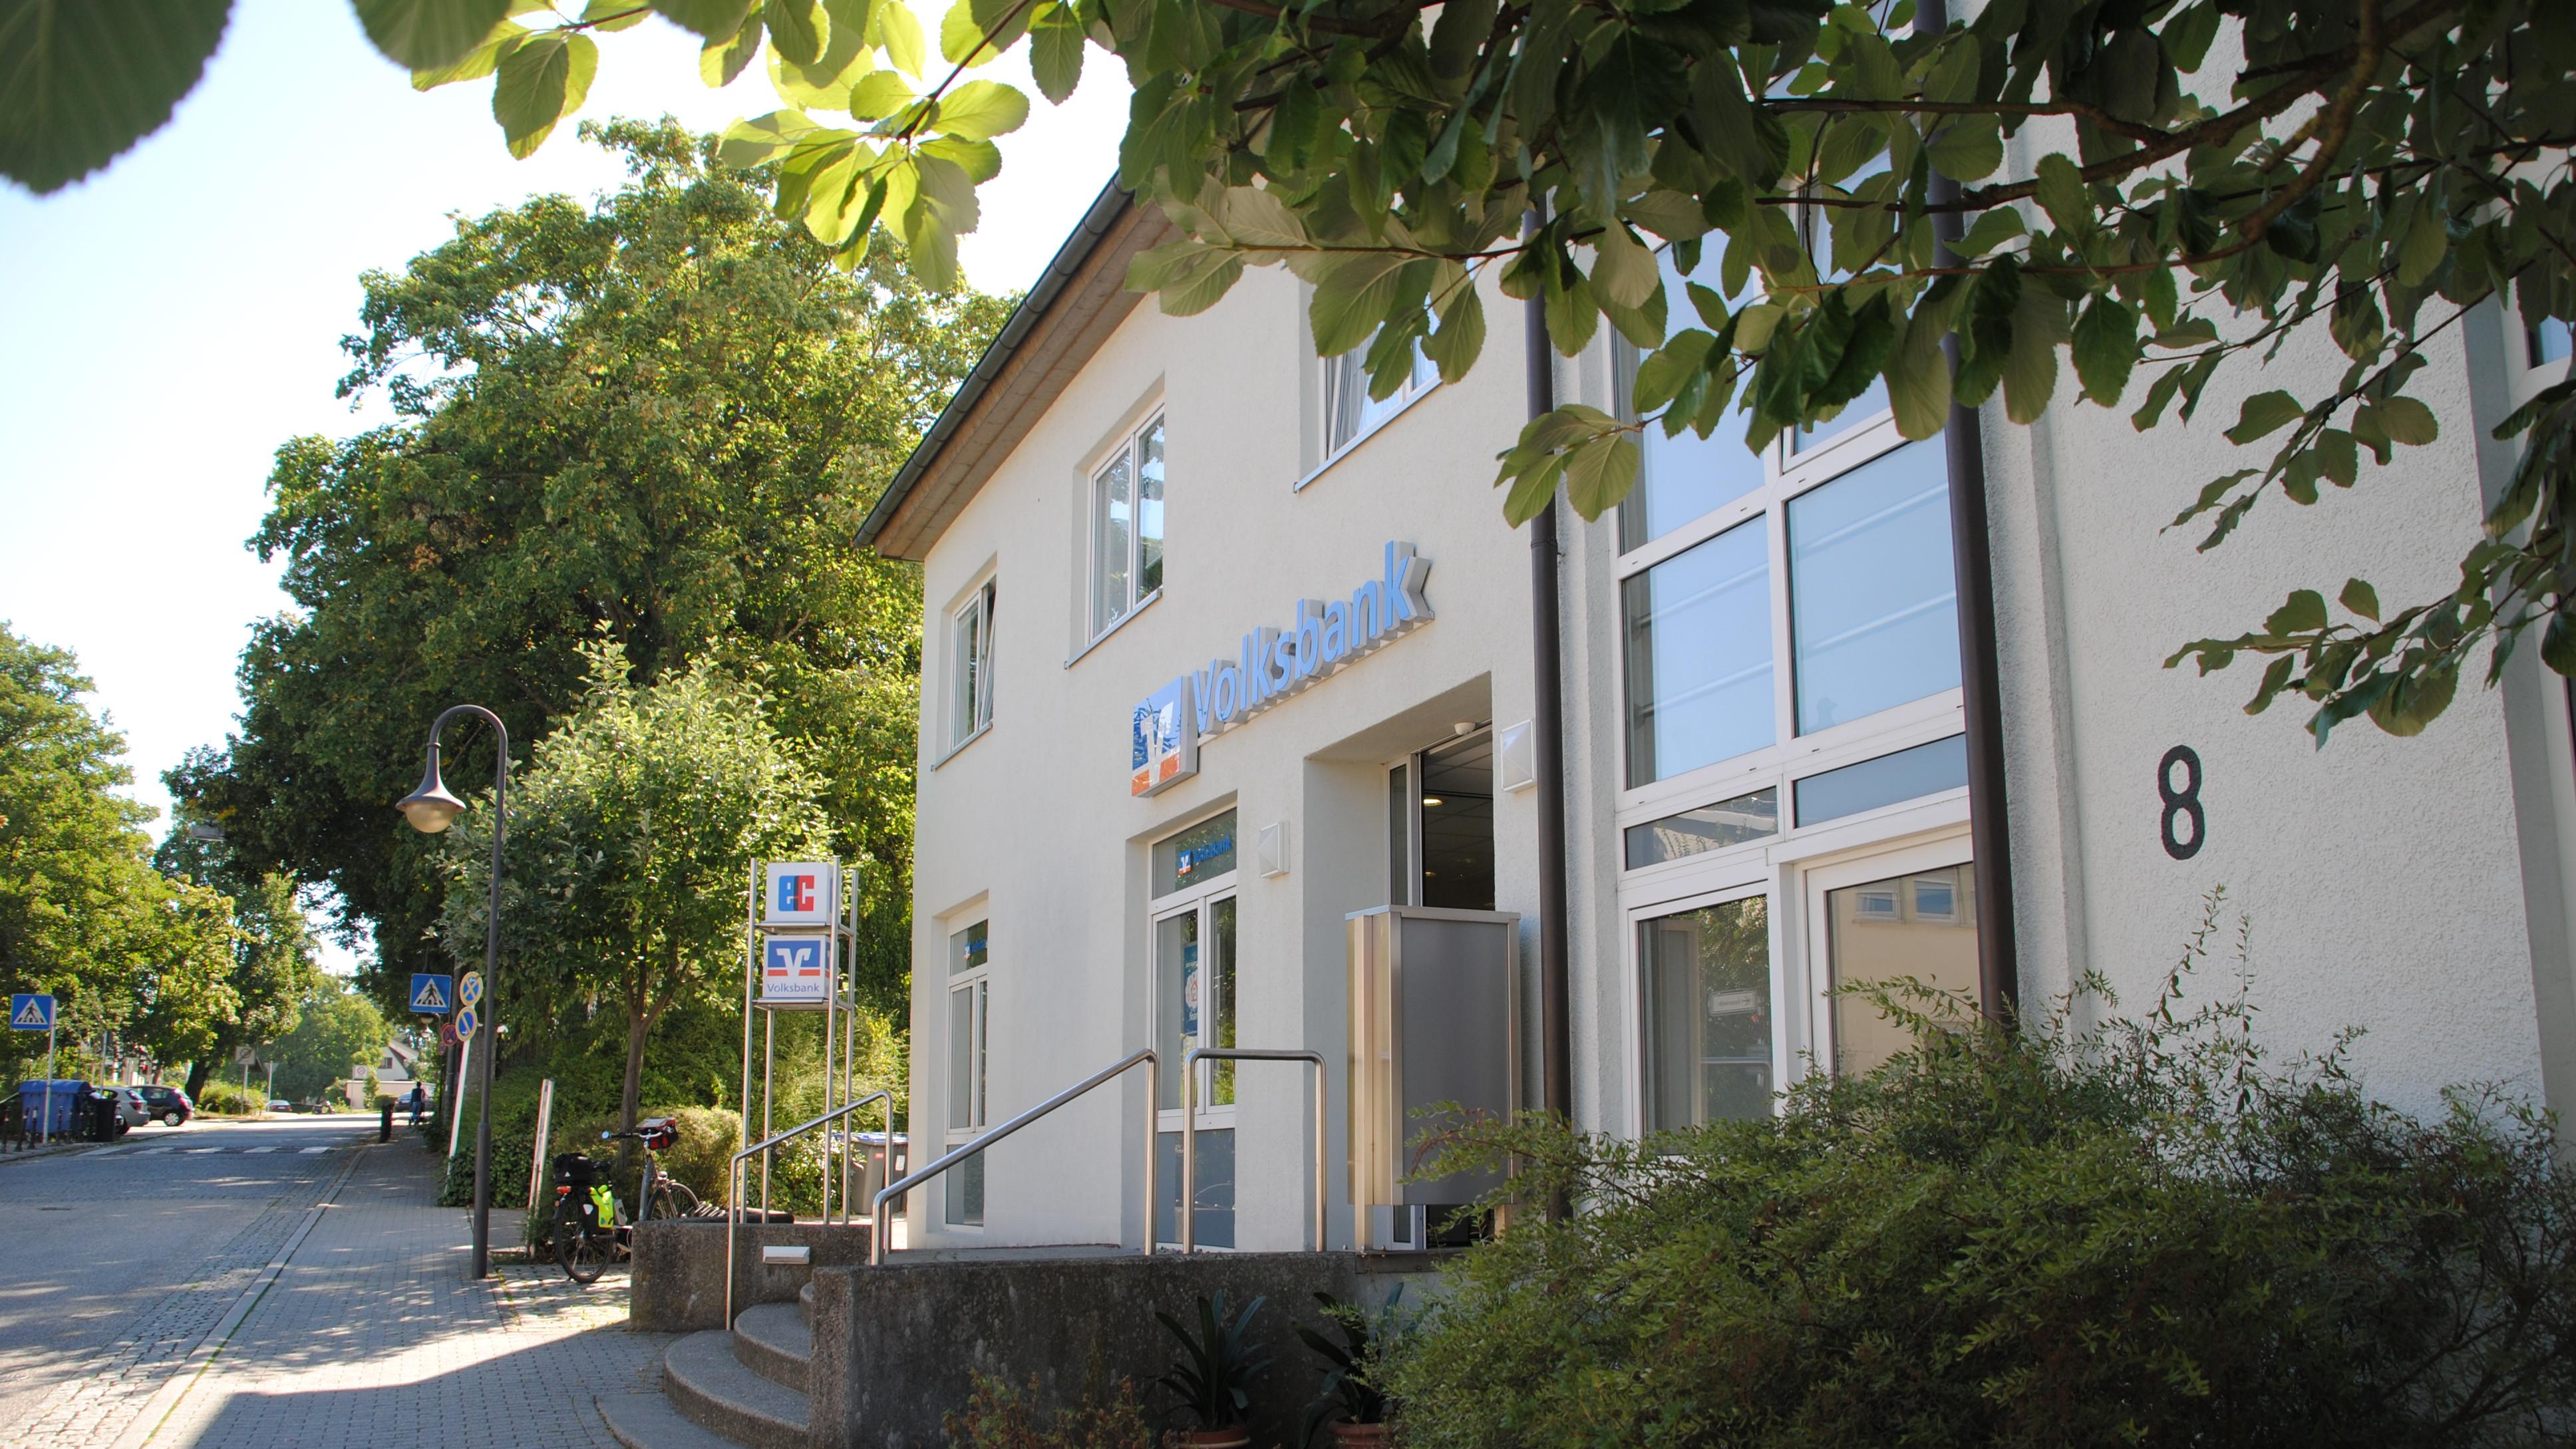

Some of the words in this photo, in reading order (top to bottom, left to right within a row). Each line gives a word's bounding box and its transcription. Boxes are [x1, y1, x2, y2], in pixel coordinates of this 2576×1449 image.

[1192, 540, 1414, 734] Volksbank
[2158, 744, 2205, 860] 8
[767, 983, 819, 993] Volksbank
